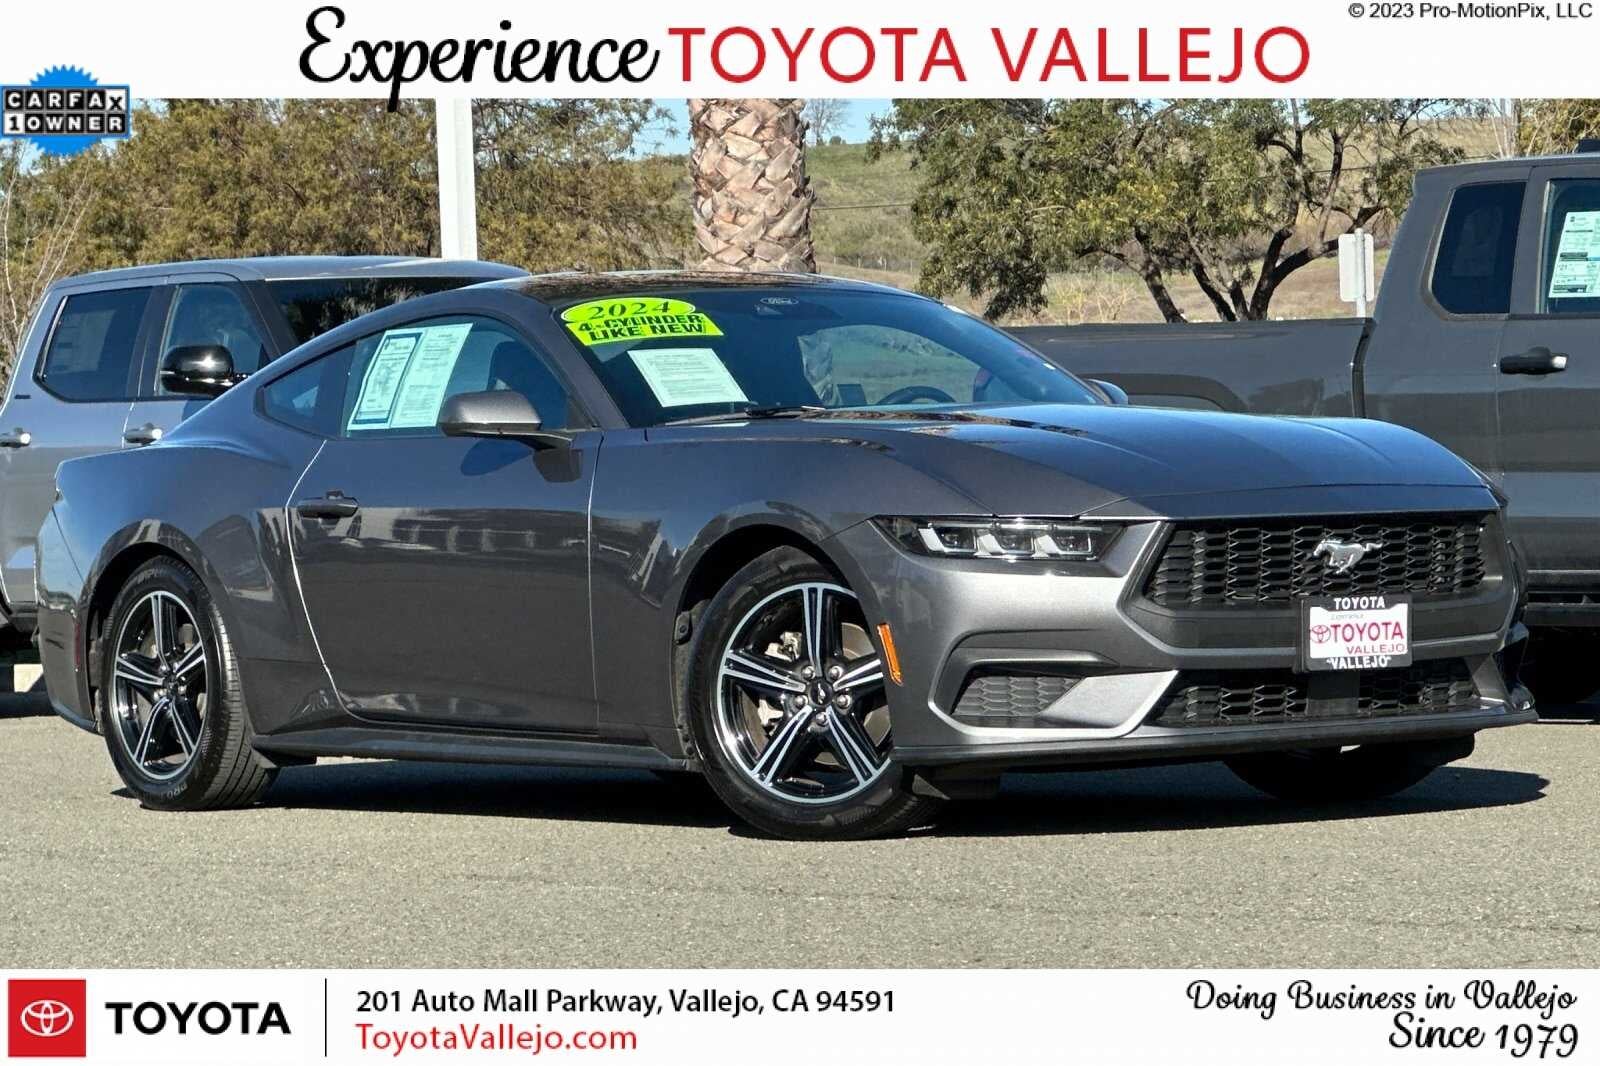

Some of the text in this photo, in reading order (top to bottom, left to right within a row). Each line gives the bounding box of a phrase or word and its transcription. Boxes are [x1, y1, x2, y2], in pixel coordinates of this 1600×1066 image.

[587, 302, 671, 320] 2024
[589, 323, 704, 342] LIKE NEW
[1333, 596, 1386, 610] TOYOTA
[1330, 621, 1404, 643] TOYOTA
[1346, 643, 1405, 655] VALLEJO
